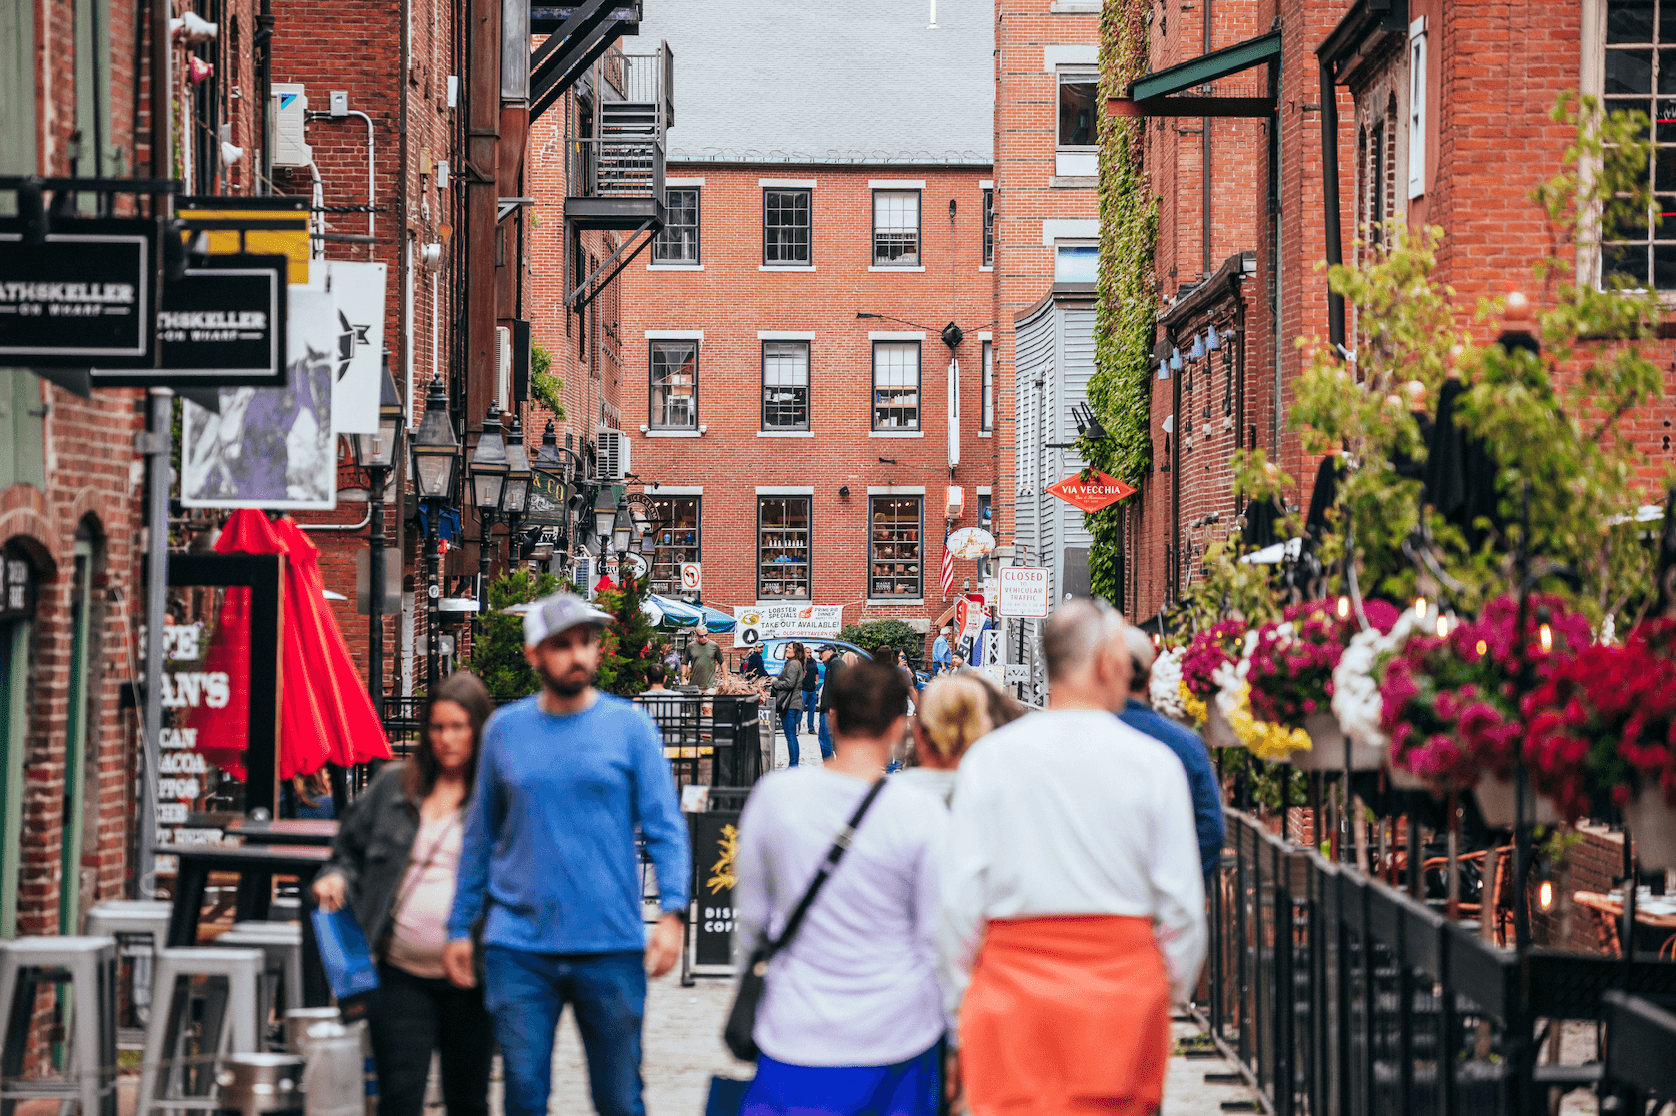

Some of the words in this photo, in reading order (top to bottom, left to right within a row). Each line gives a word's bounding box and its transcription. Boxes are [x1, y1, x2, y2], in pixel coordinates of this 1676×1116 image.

[0, 282, 135, 304] ATHSKELLER
[156, 311, 267, 330] THSKELLER
[1062, 486, 1077, 494] VIA
[1080, 486, 1120, 494] VECCHIA
[630, 494, 640, 502] ICE
[641, 497, 657, 520] CREAM
[606, 565, 645, 575] RIY'S
[1005, 572, 1042, 581] CLOSED
[161, 671, 230, 708] AN'S
